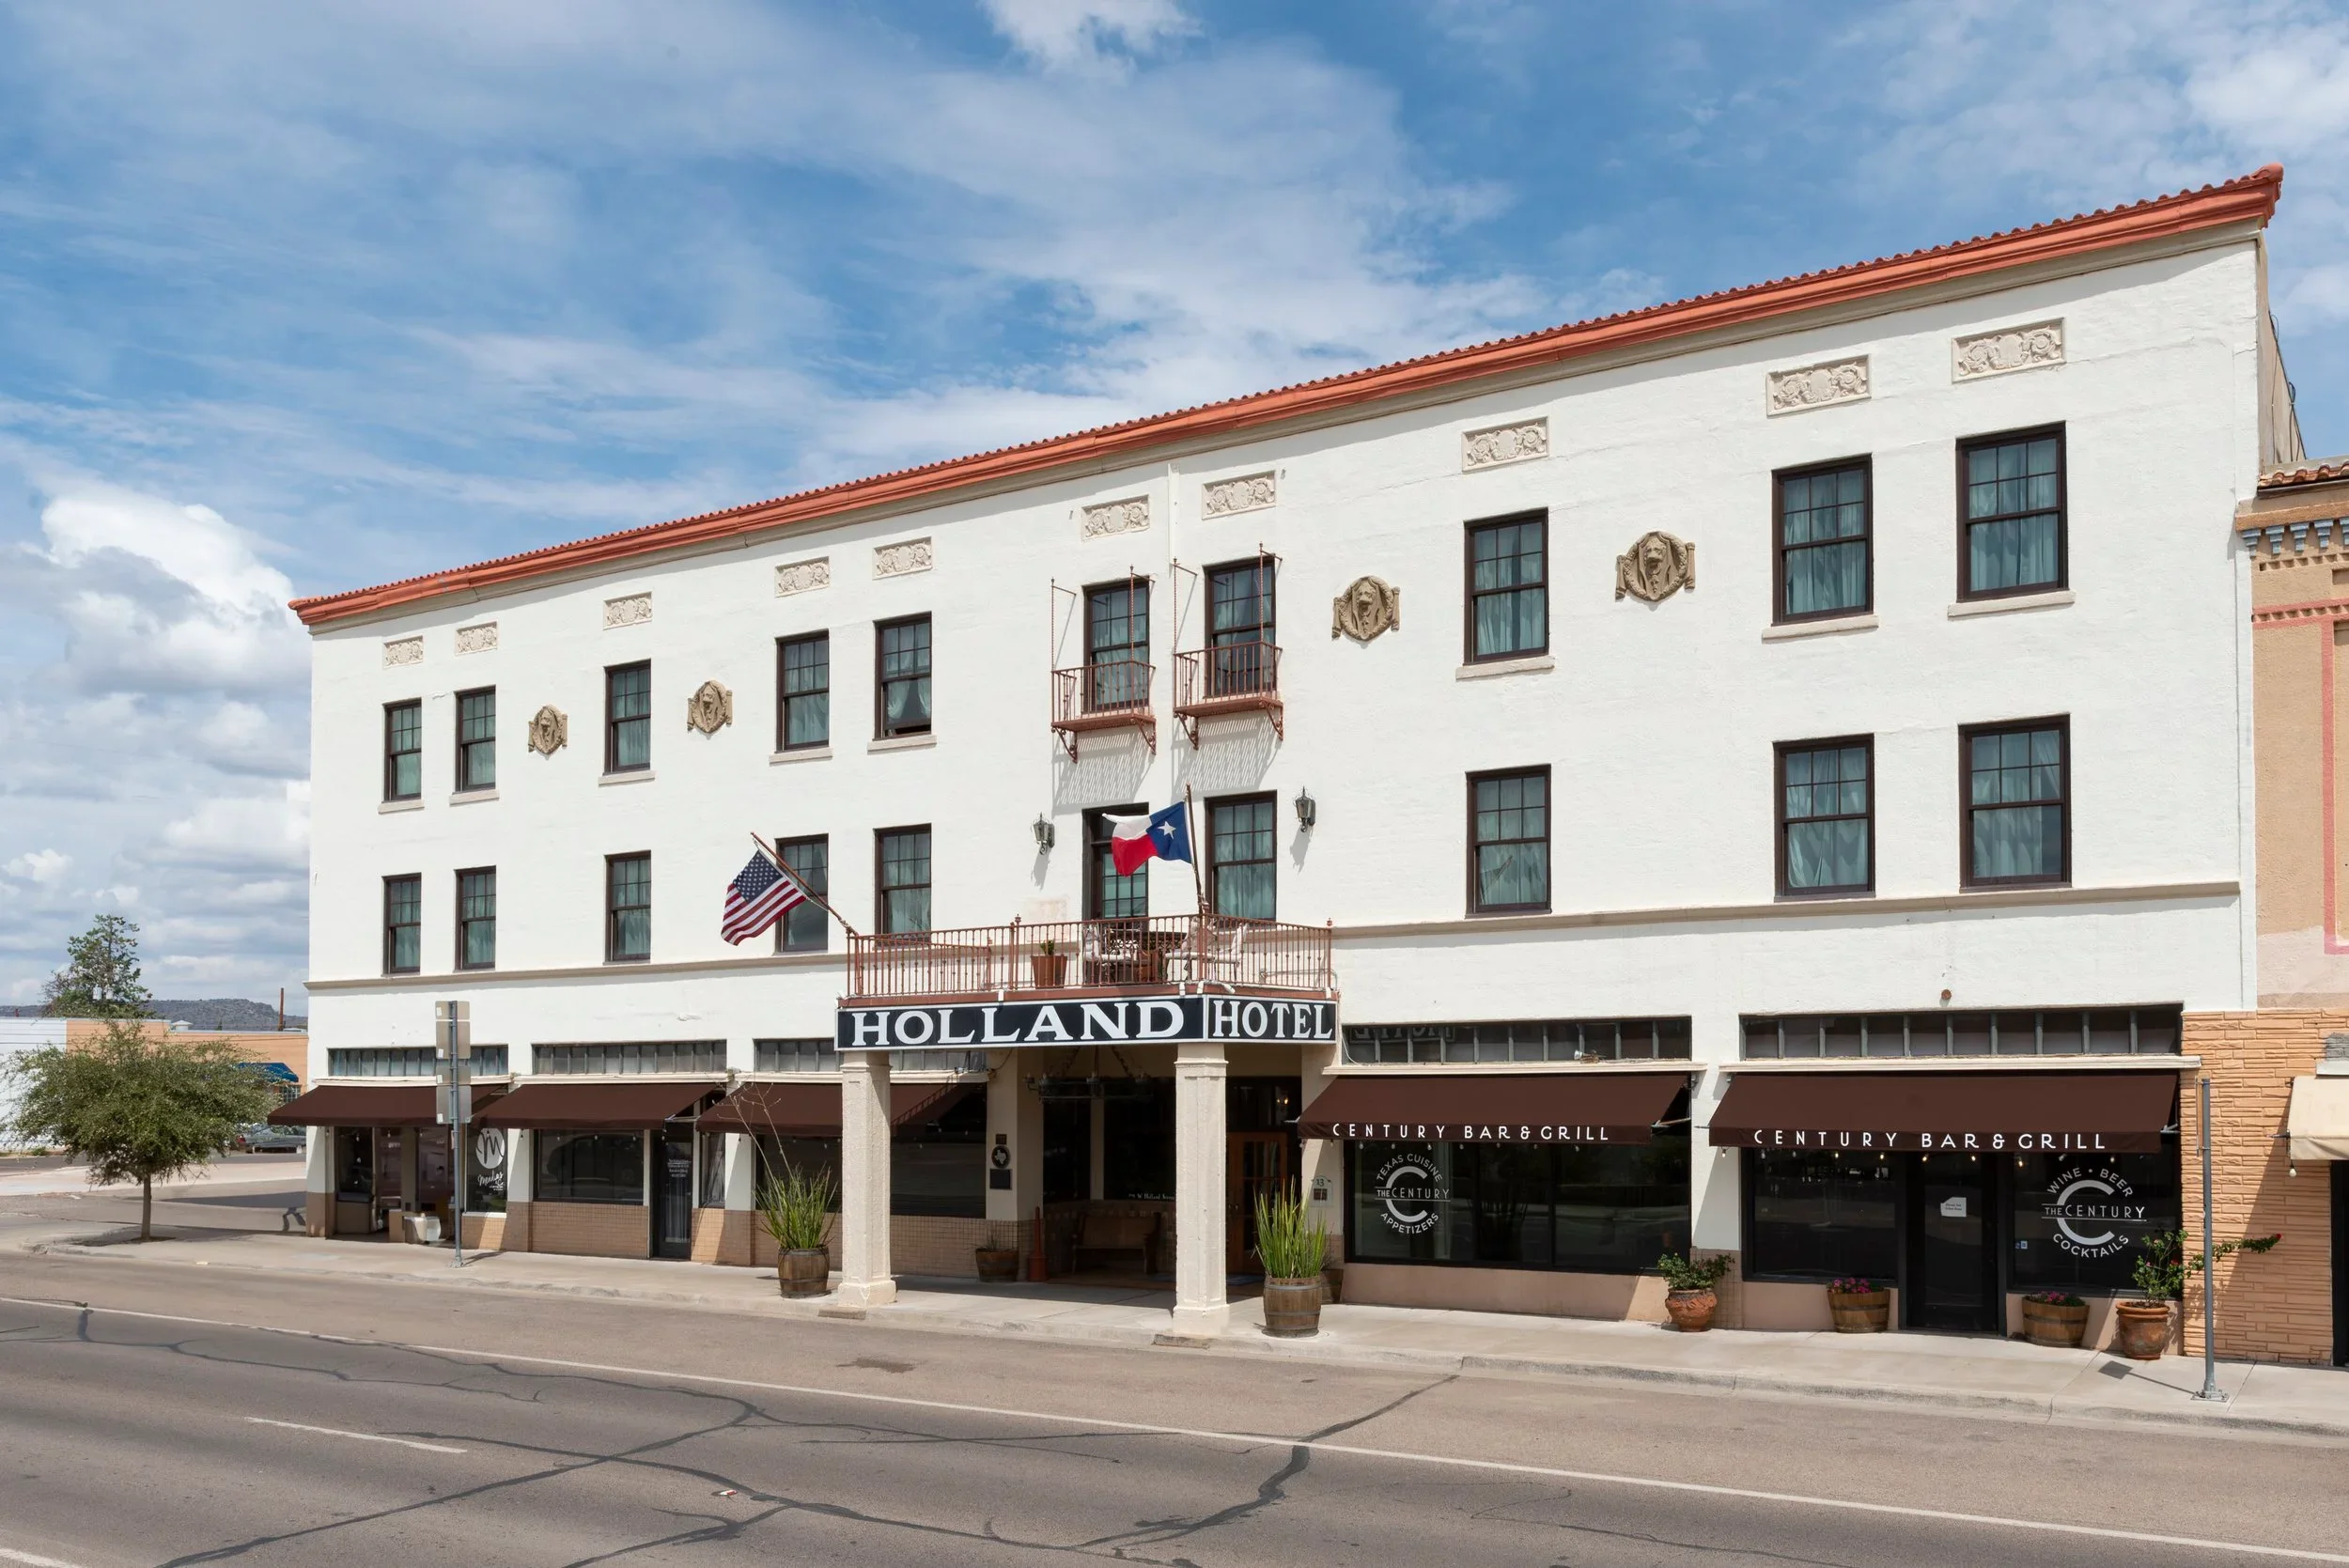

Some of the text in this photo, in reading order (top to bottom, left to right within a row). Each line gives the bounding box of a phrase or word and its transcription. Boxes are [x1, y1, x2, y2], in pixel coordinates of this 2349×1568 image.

[851, 1000, 1333, 1047] HOLLAND HOTEL
[1332, 1123, 1445, 1139] CENTURY
[1753, 1129, 1897, 1147] CENTURY
[1376, 1153, 1443, 1183] TEXAS CUISINE
[1377, 1187, 1450, 1200] THE CENTURY
[2046, 1167, 2134, 1198] WINE BEER
[2045, 1204, 2145, 1219] THE CENTURY
[1380, 1212, 1439, 1234] APPETIZERS
[2053, 1233, 2129, 1258] COCKTAILS
